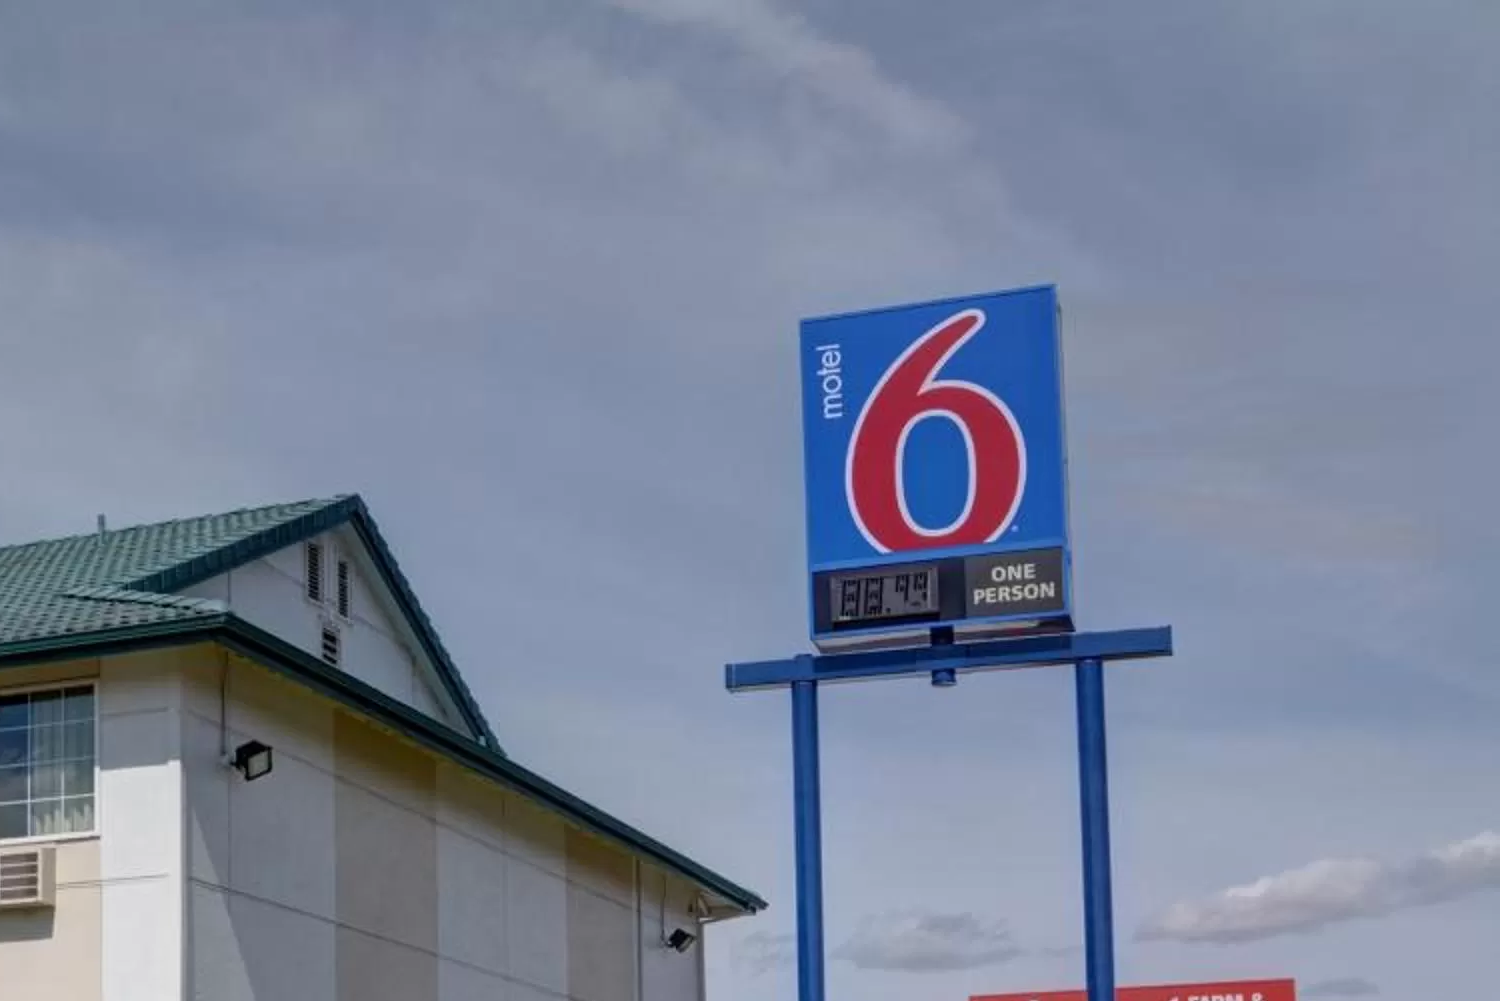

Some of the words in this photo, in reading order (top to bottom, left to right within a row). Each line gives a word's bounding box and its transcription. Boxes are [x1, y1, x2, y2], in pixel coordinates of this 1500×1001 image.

[816, 344, 843, 419] motel
[845, 308, 1027, 555] 6
[973, 581, 1055, 605] PERSON
[991, 563, 1037, 582] ONE
